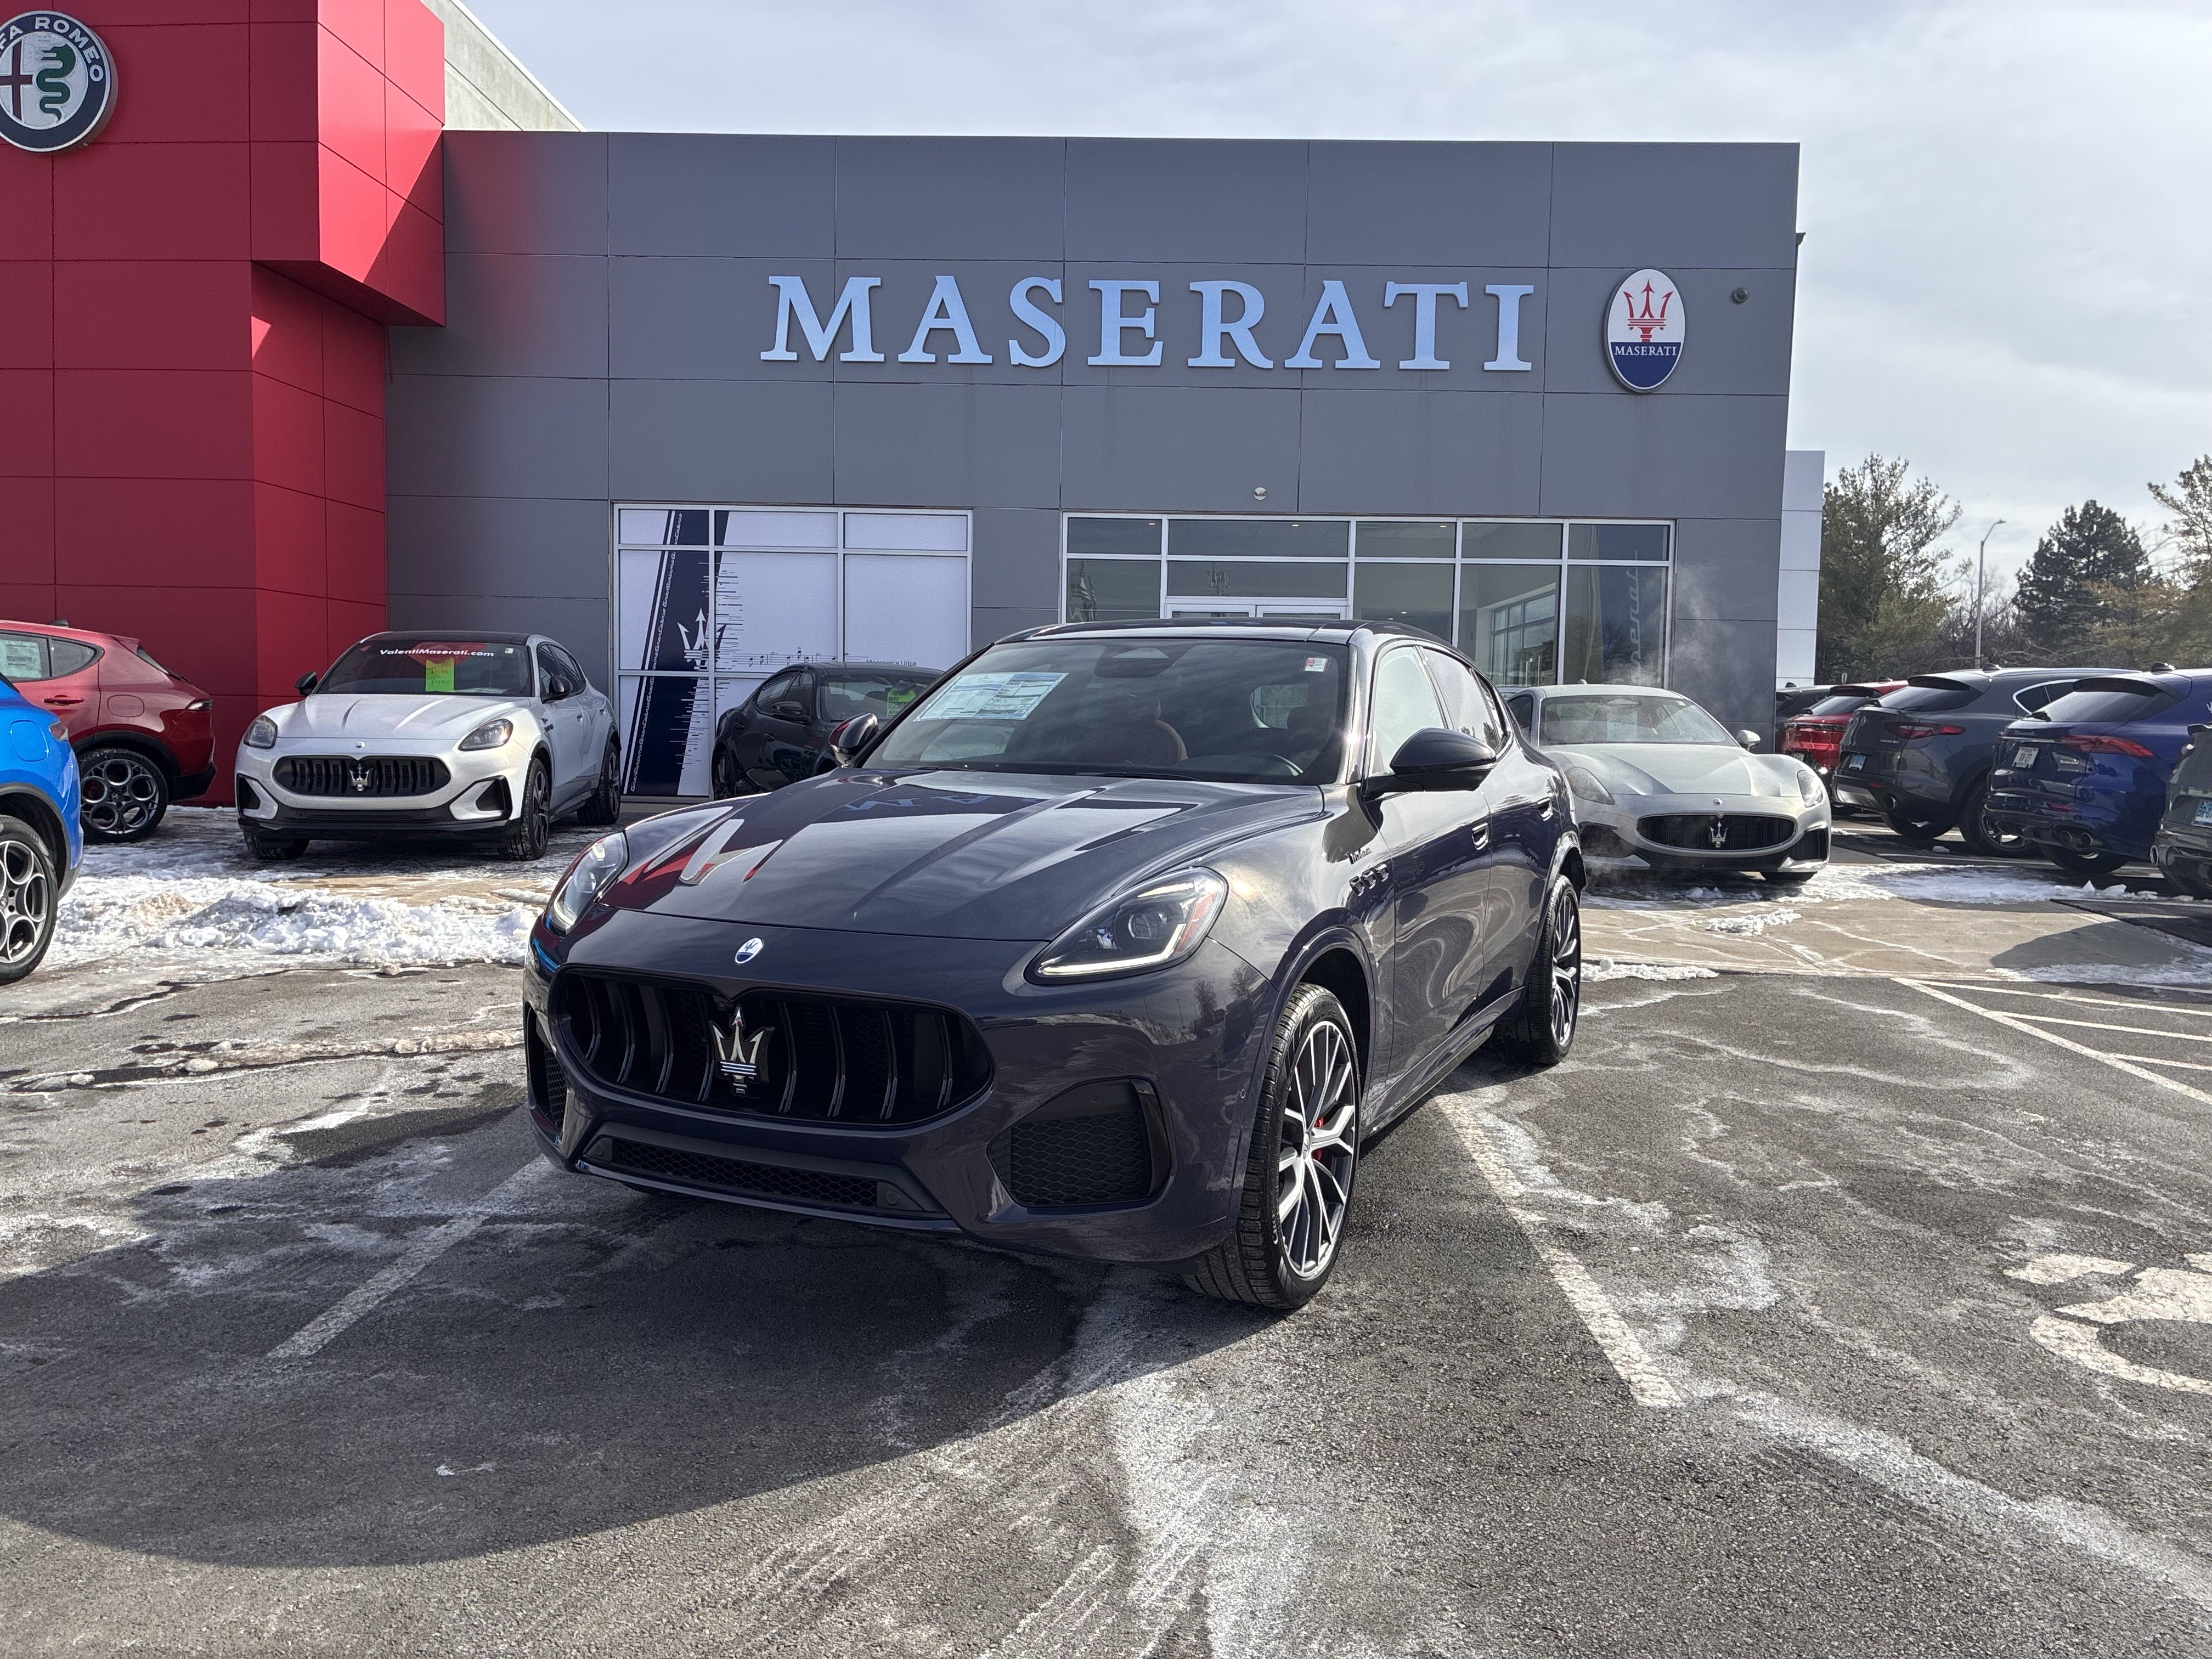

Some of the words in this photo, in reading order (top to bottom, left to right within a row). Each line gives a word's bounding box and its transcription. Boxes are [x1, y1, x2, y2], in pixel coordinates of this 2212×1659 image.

[35, 17, 104, 82] ROMEO
[761, 276, 1534, 370] MASERATI
[1614, 346, 1677, 356] MASERATI
